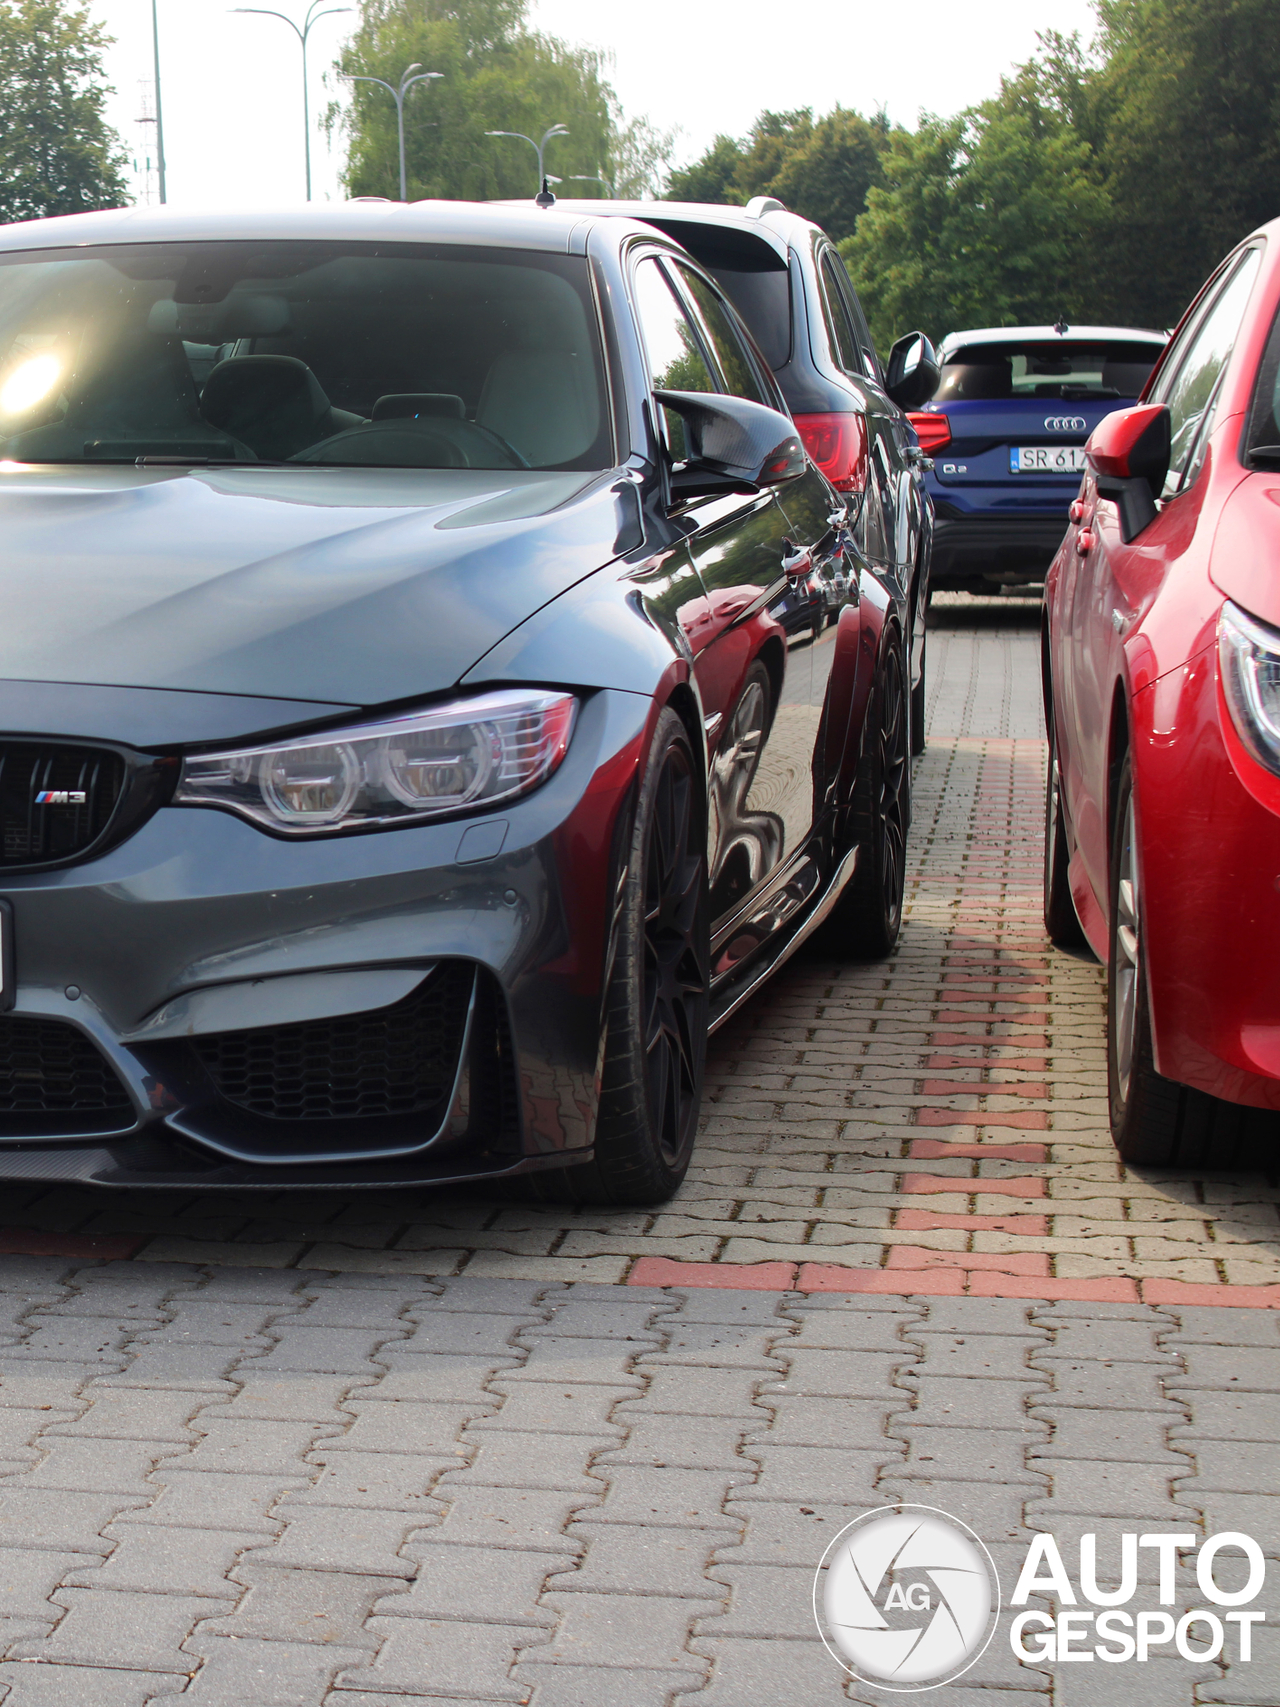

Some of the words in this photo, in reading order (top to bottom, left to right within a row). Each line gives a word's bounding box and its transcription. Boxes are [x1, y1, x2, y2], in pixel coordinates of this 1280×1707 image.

[1023, 449, 1048, 467] SR
[942, 463, 968, 474] Q2
[38, 790, 86, 803] M3
